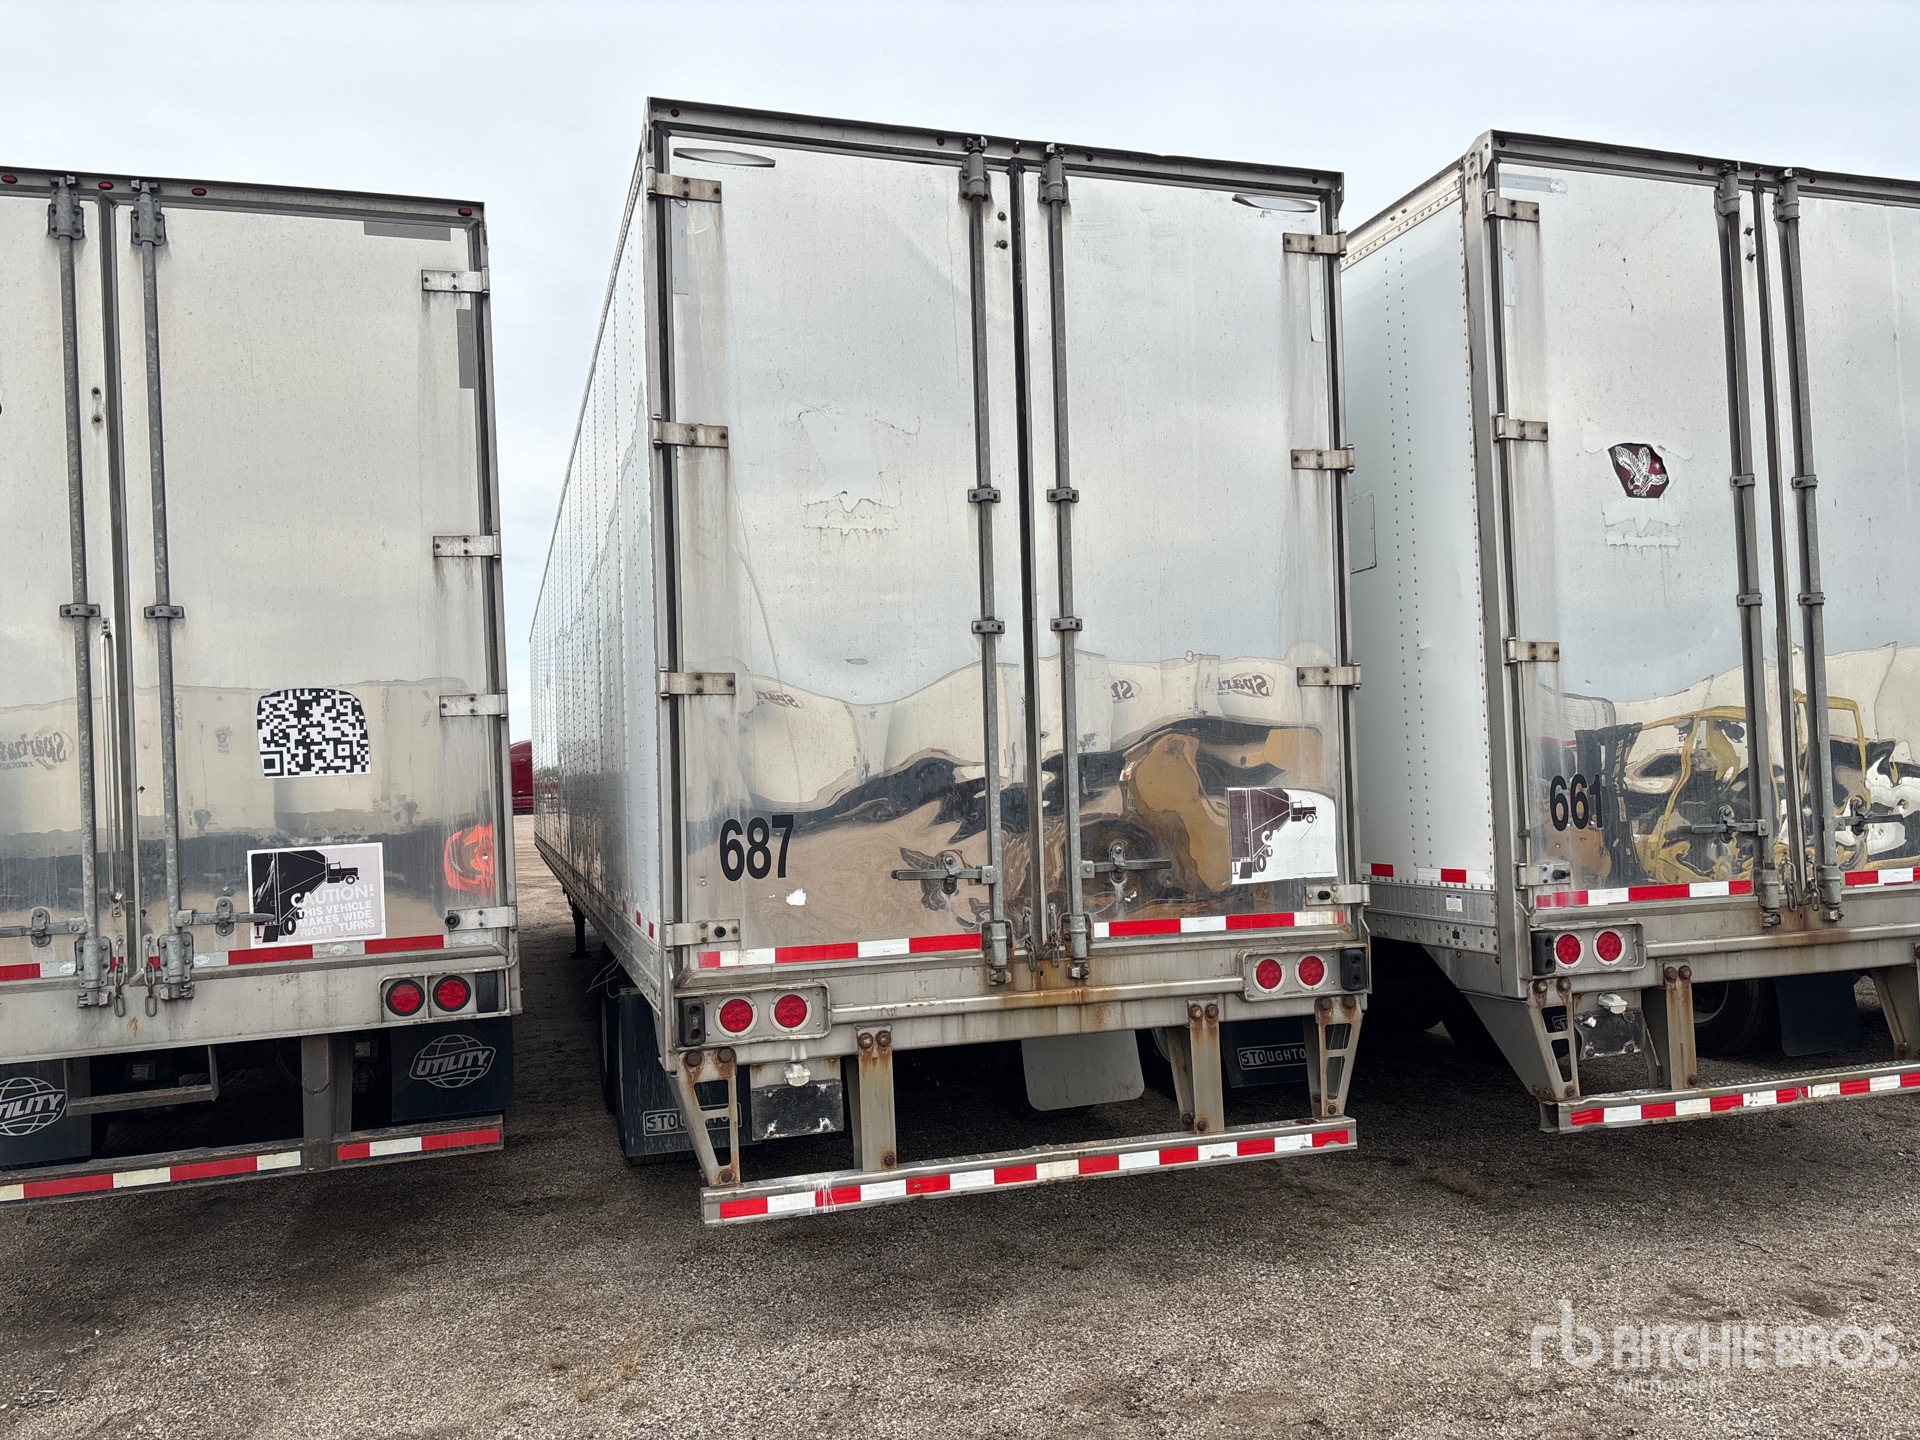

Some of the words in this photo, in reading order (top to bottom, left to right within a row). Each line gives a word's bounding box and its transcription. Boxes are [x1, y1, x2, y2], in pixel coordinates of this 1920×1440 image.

[1550, 773, 1604, 832] 661
[719, 814, 794, 882] 687
[291, 883, 376, 909] CAUTION!
[296, 905, 324, 918] THIS
[326, 900, 373, 914] VEHICLE
[300, 913, 340, 928] MAKES
[342, 909, 373, 922] WIDE
[300, 924, 333, 938] RIGHT
[338, 918, 376, 932] TURNS
[416, 1050, 491, 1076] UTILITY
